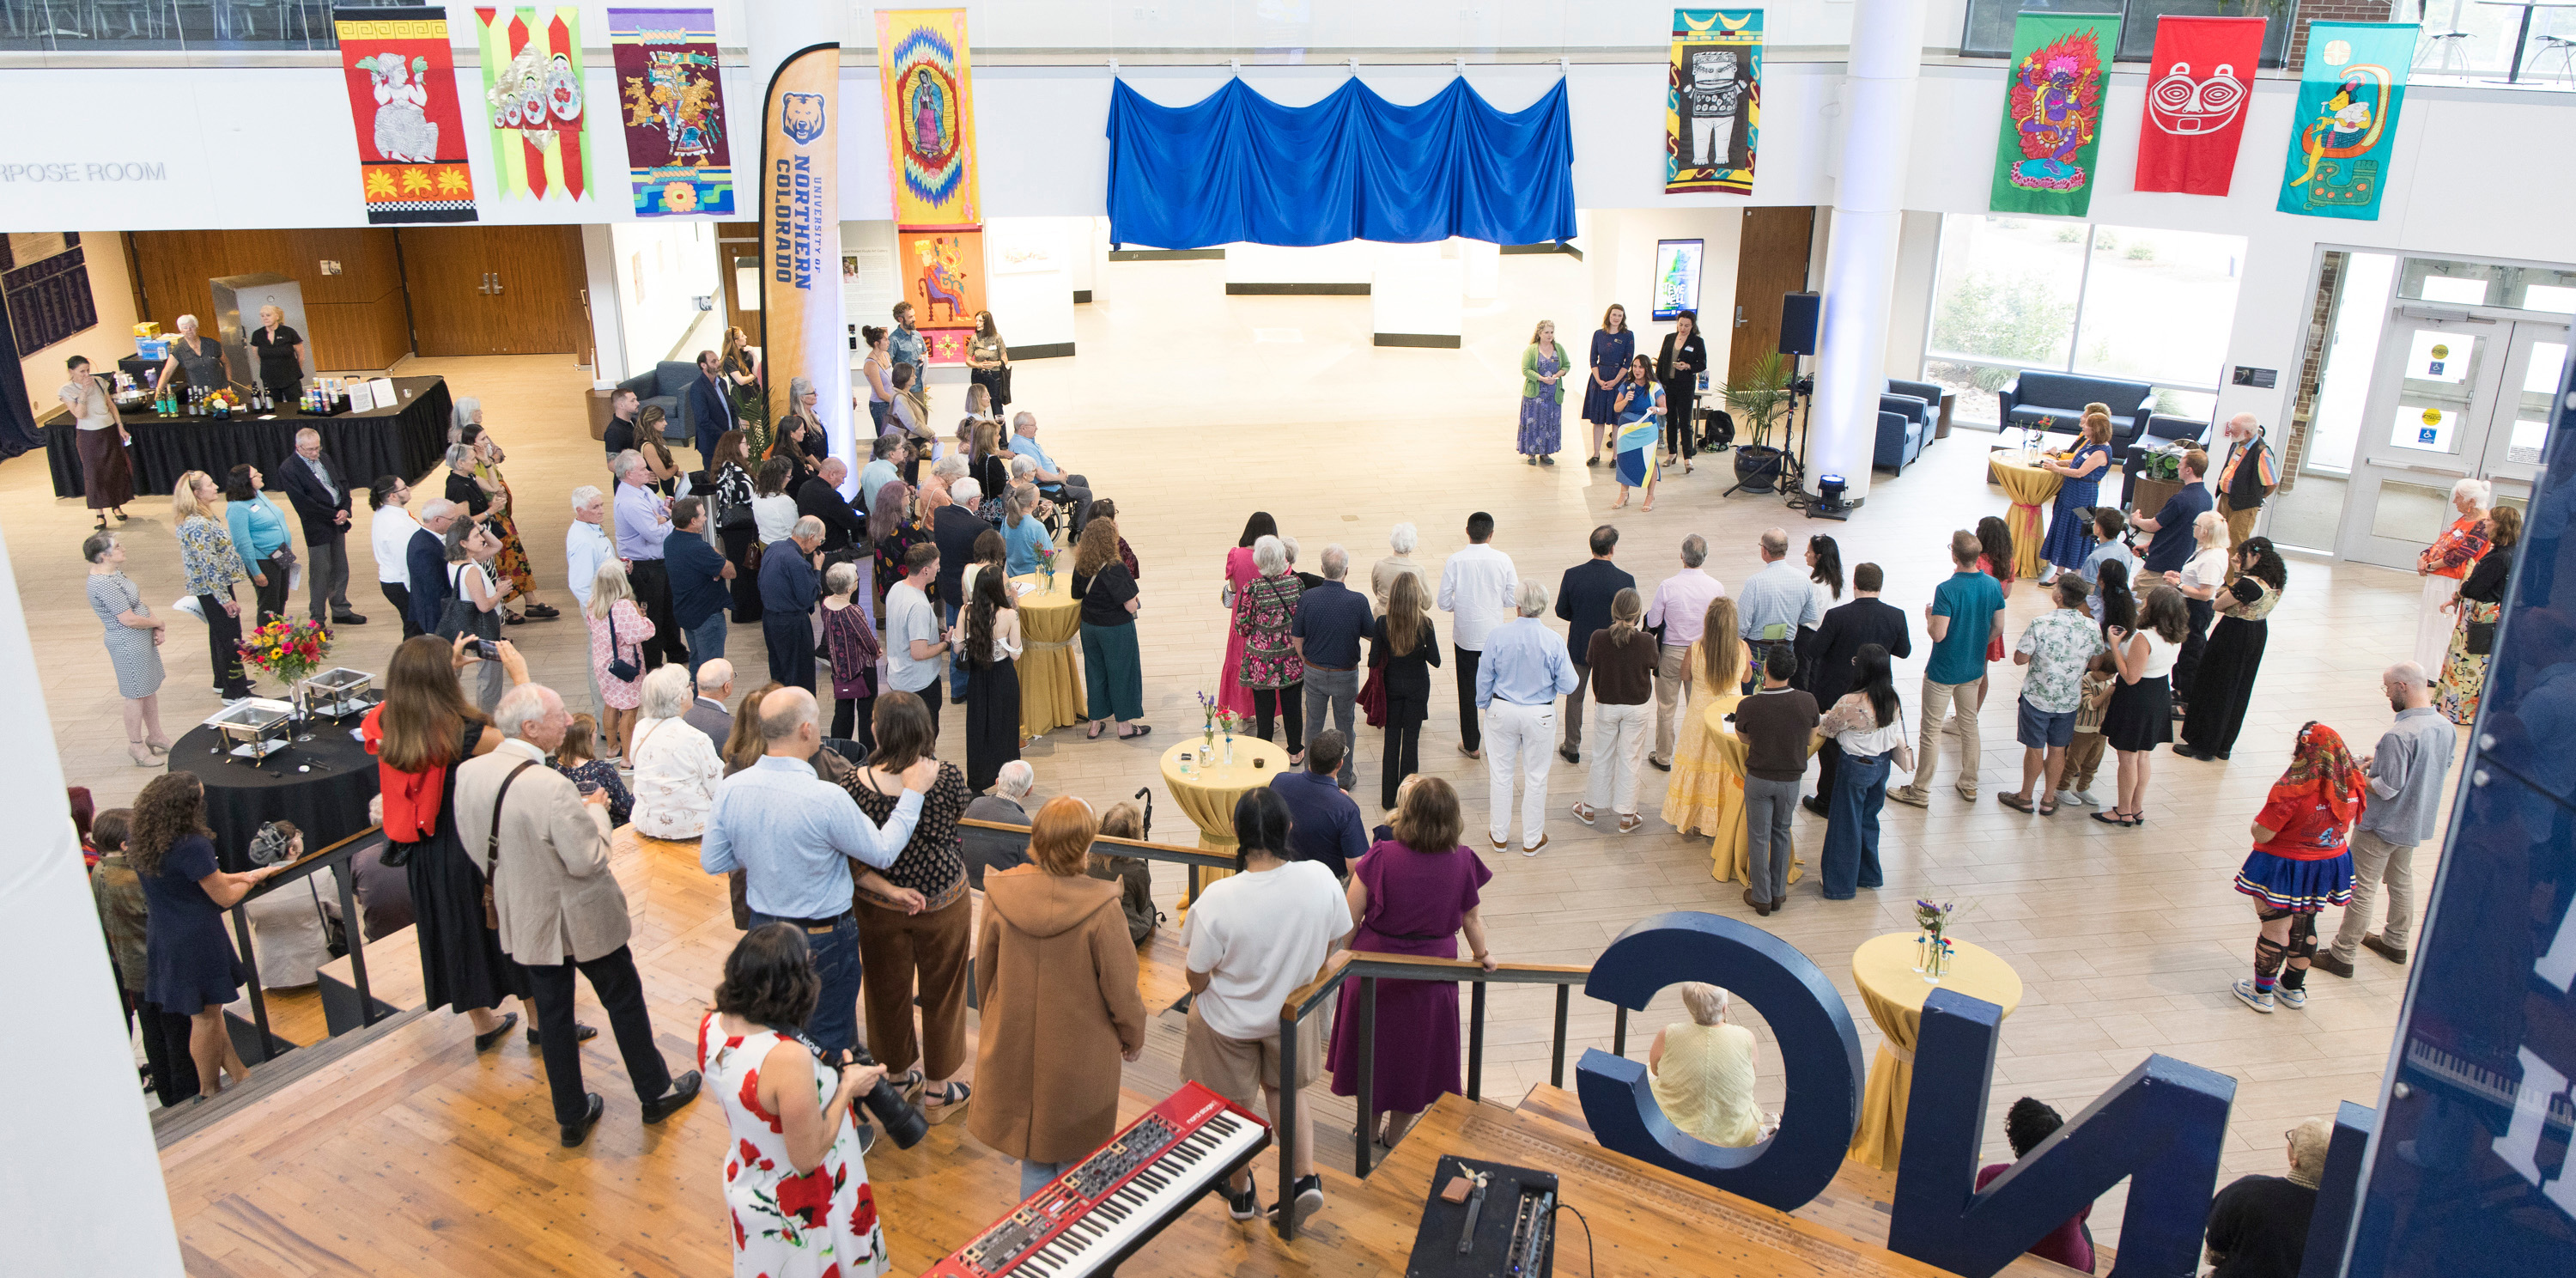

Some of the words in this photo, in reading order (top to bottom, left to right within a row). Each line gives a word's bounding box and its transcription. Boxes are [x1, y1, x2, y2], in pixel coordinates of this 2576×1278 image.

[86, 161, 167, 182] ROOM
[775, 158, 792, 283] COLORADO
[794, 154, 811, 291] NORTHERN
[813, 176, 822, 254] UNIVERSITY
[814, 258, 822, 274] OF
[796, 1033, 822, 1055] SONY
